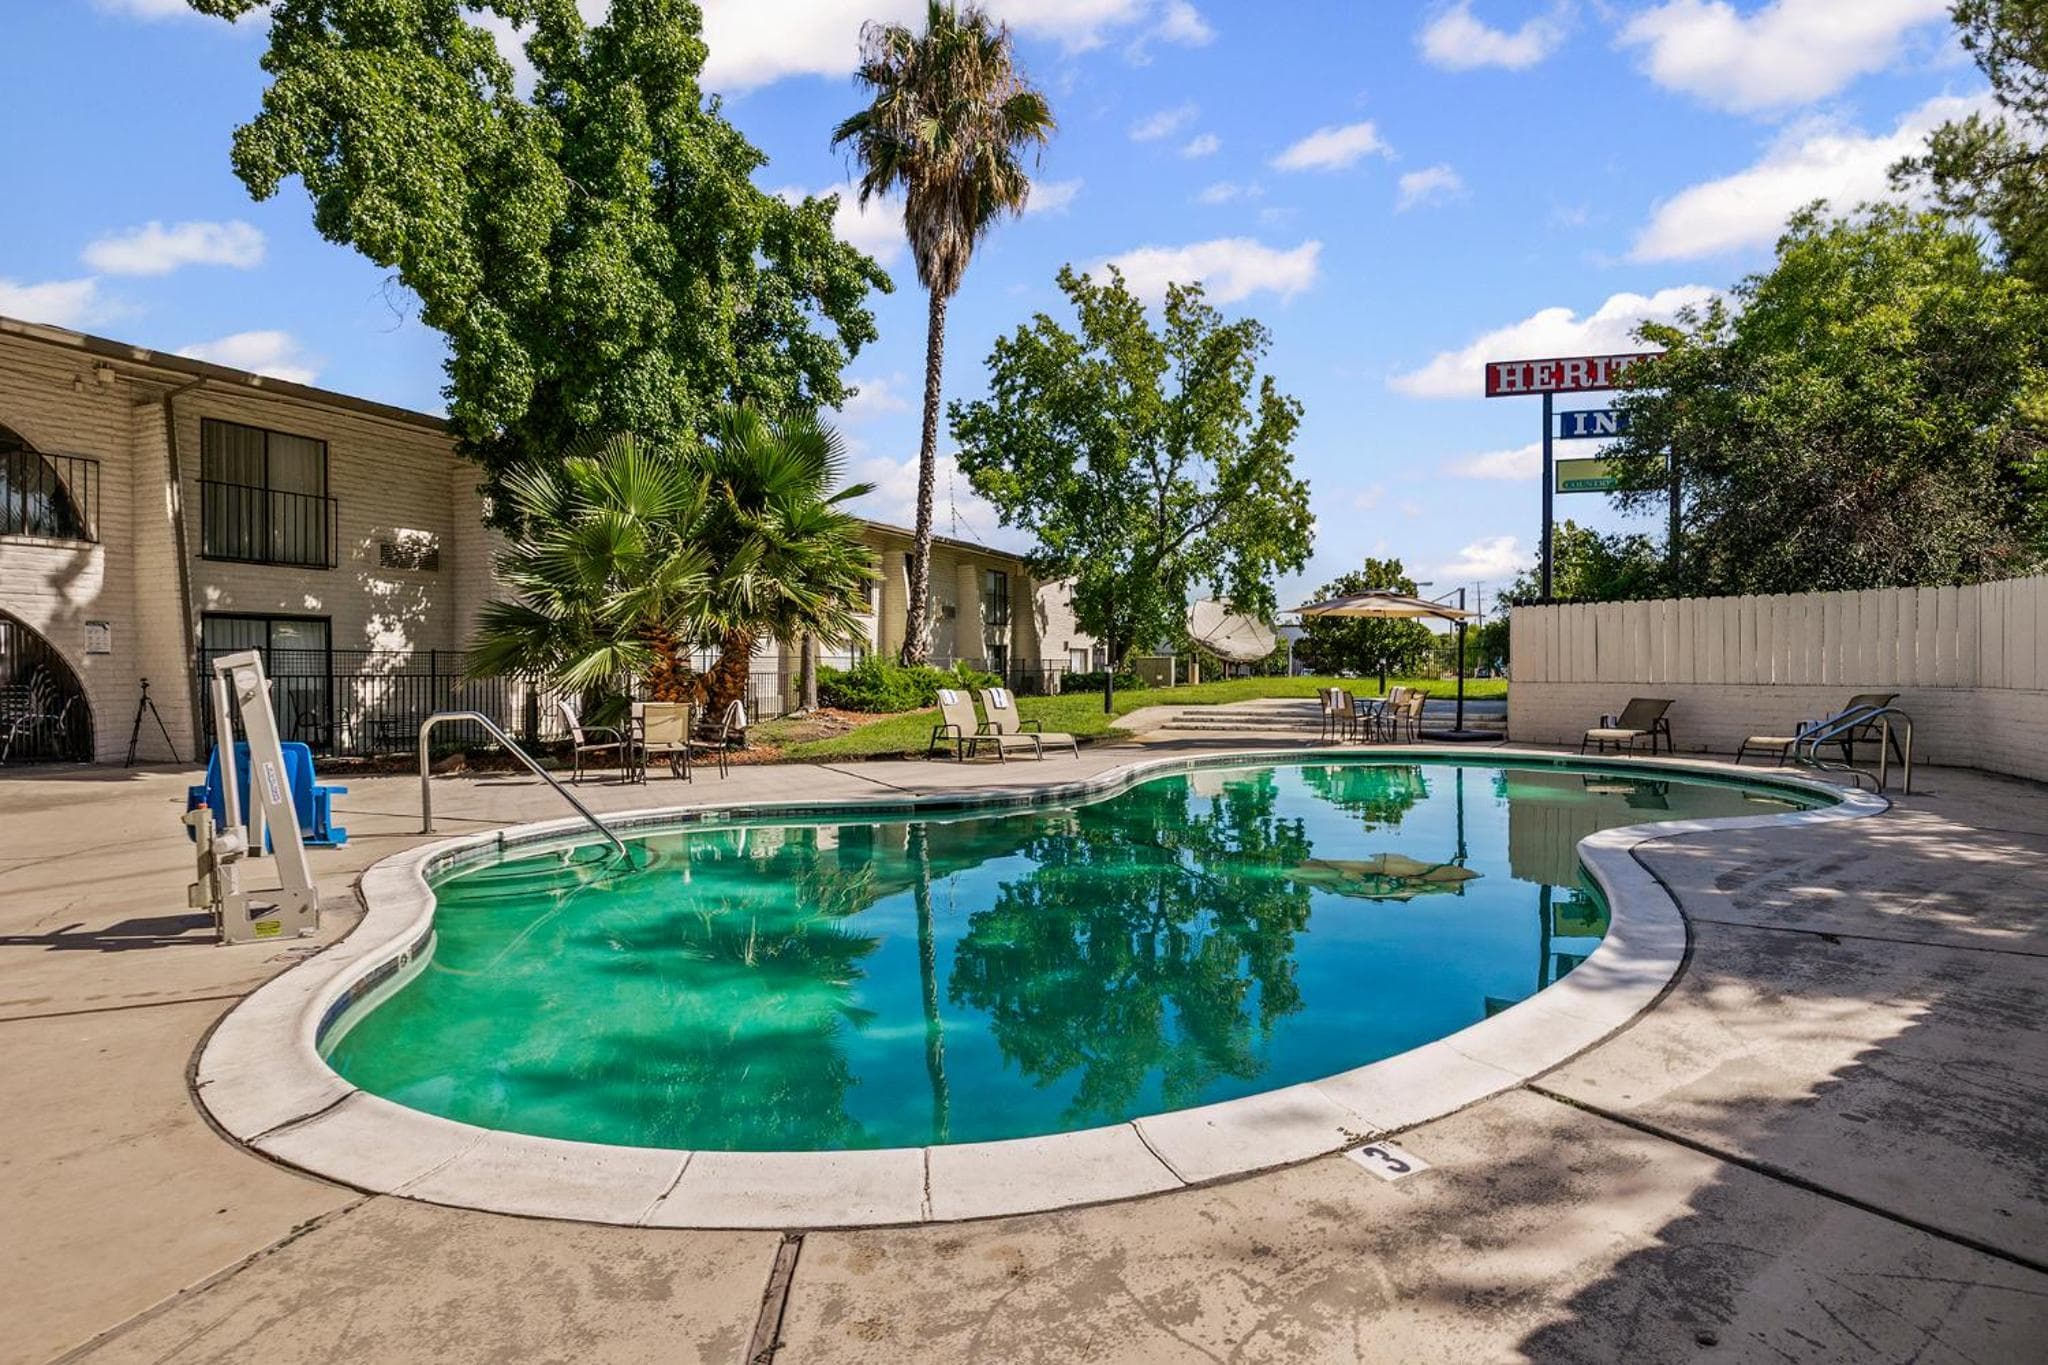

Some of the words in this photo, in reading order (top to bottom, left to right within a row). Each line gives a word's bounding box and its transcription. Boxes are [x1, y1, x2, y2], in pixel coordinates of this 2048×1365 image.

[1496, 355, 1657, 392] HERIT
[1574, 411, 1620, 435] IN
[1362, 1146, 1411, 1173] 3
